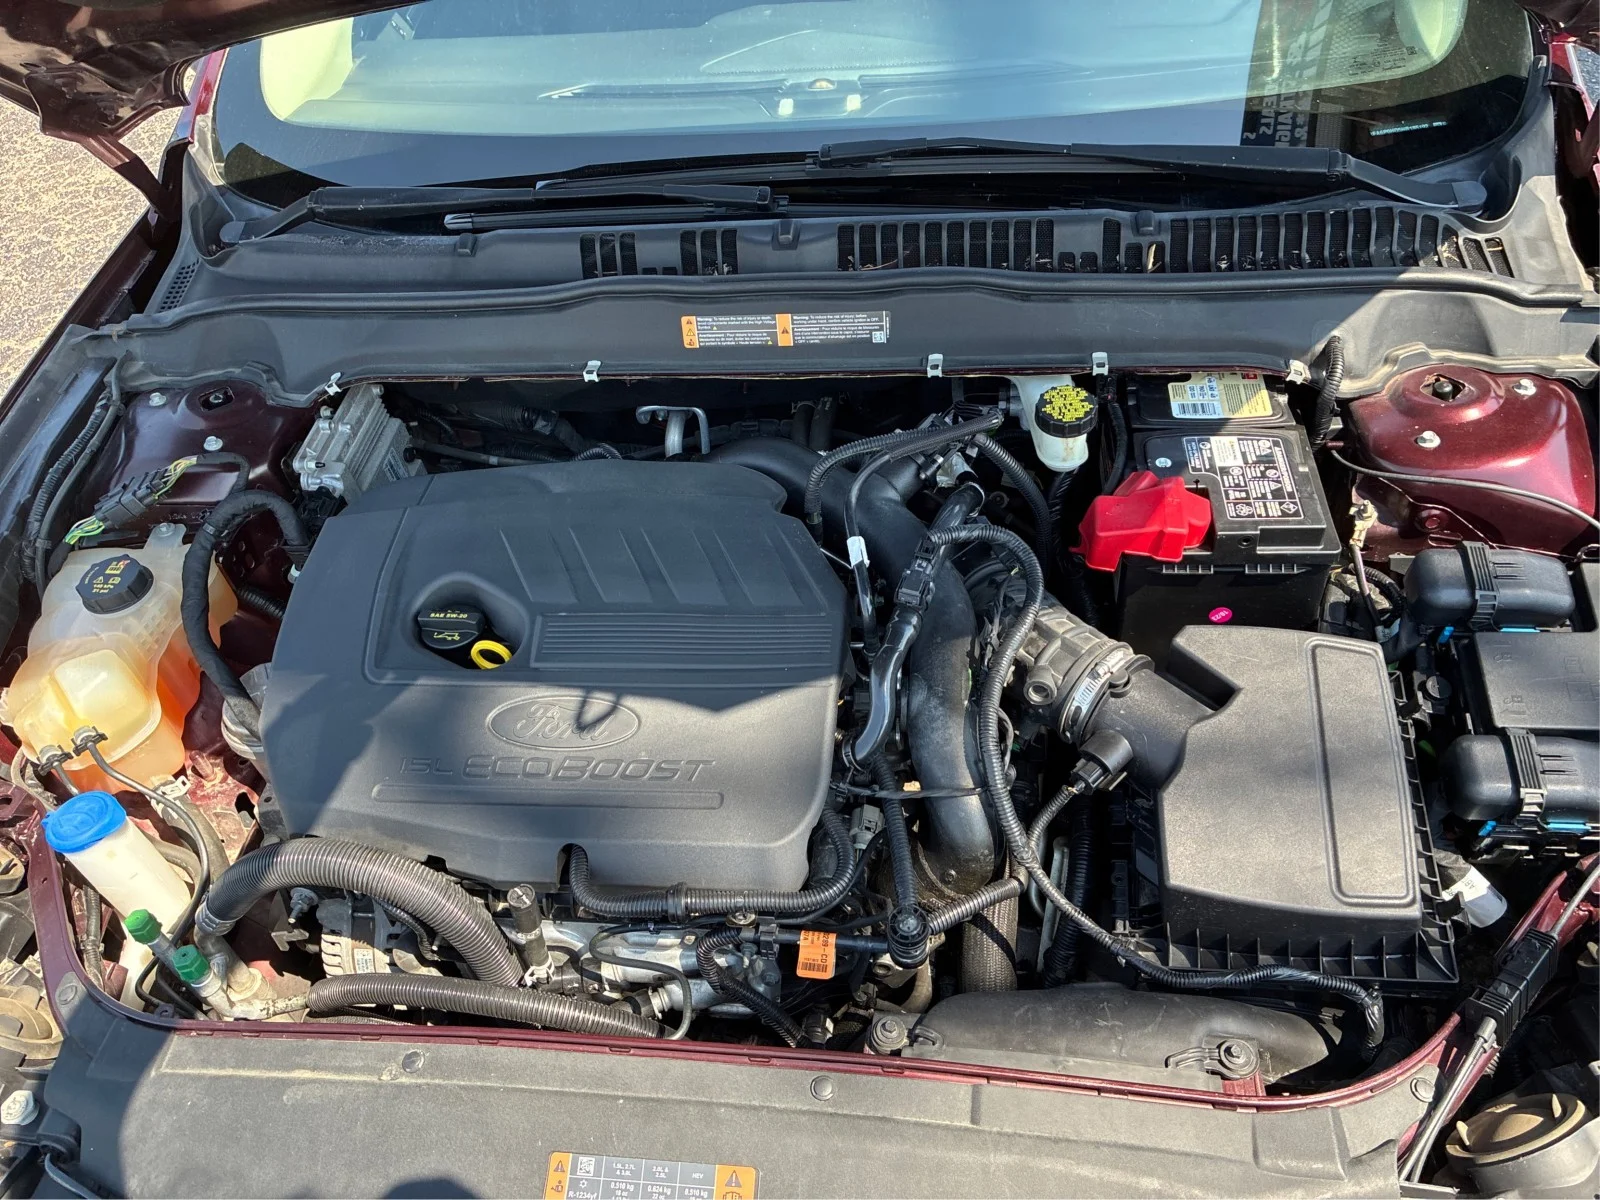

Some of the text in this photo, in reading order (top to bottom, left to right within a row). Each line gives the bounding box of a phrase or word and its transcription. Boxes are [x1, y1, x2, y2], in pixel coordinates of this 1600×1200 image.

[512, 702, 610, 741] Ford
[626, 1183, 634, 1191] kg
[664, 1186, 671, 1195] kg
[568, 1190, 597, 1200] R-1234yf
[700, 1190, 708, 1198] kg
